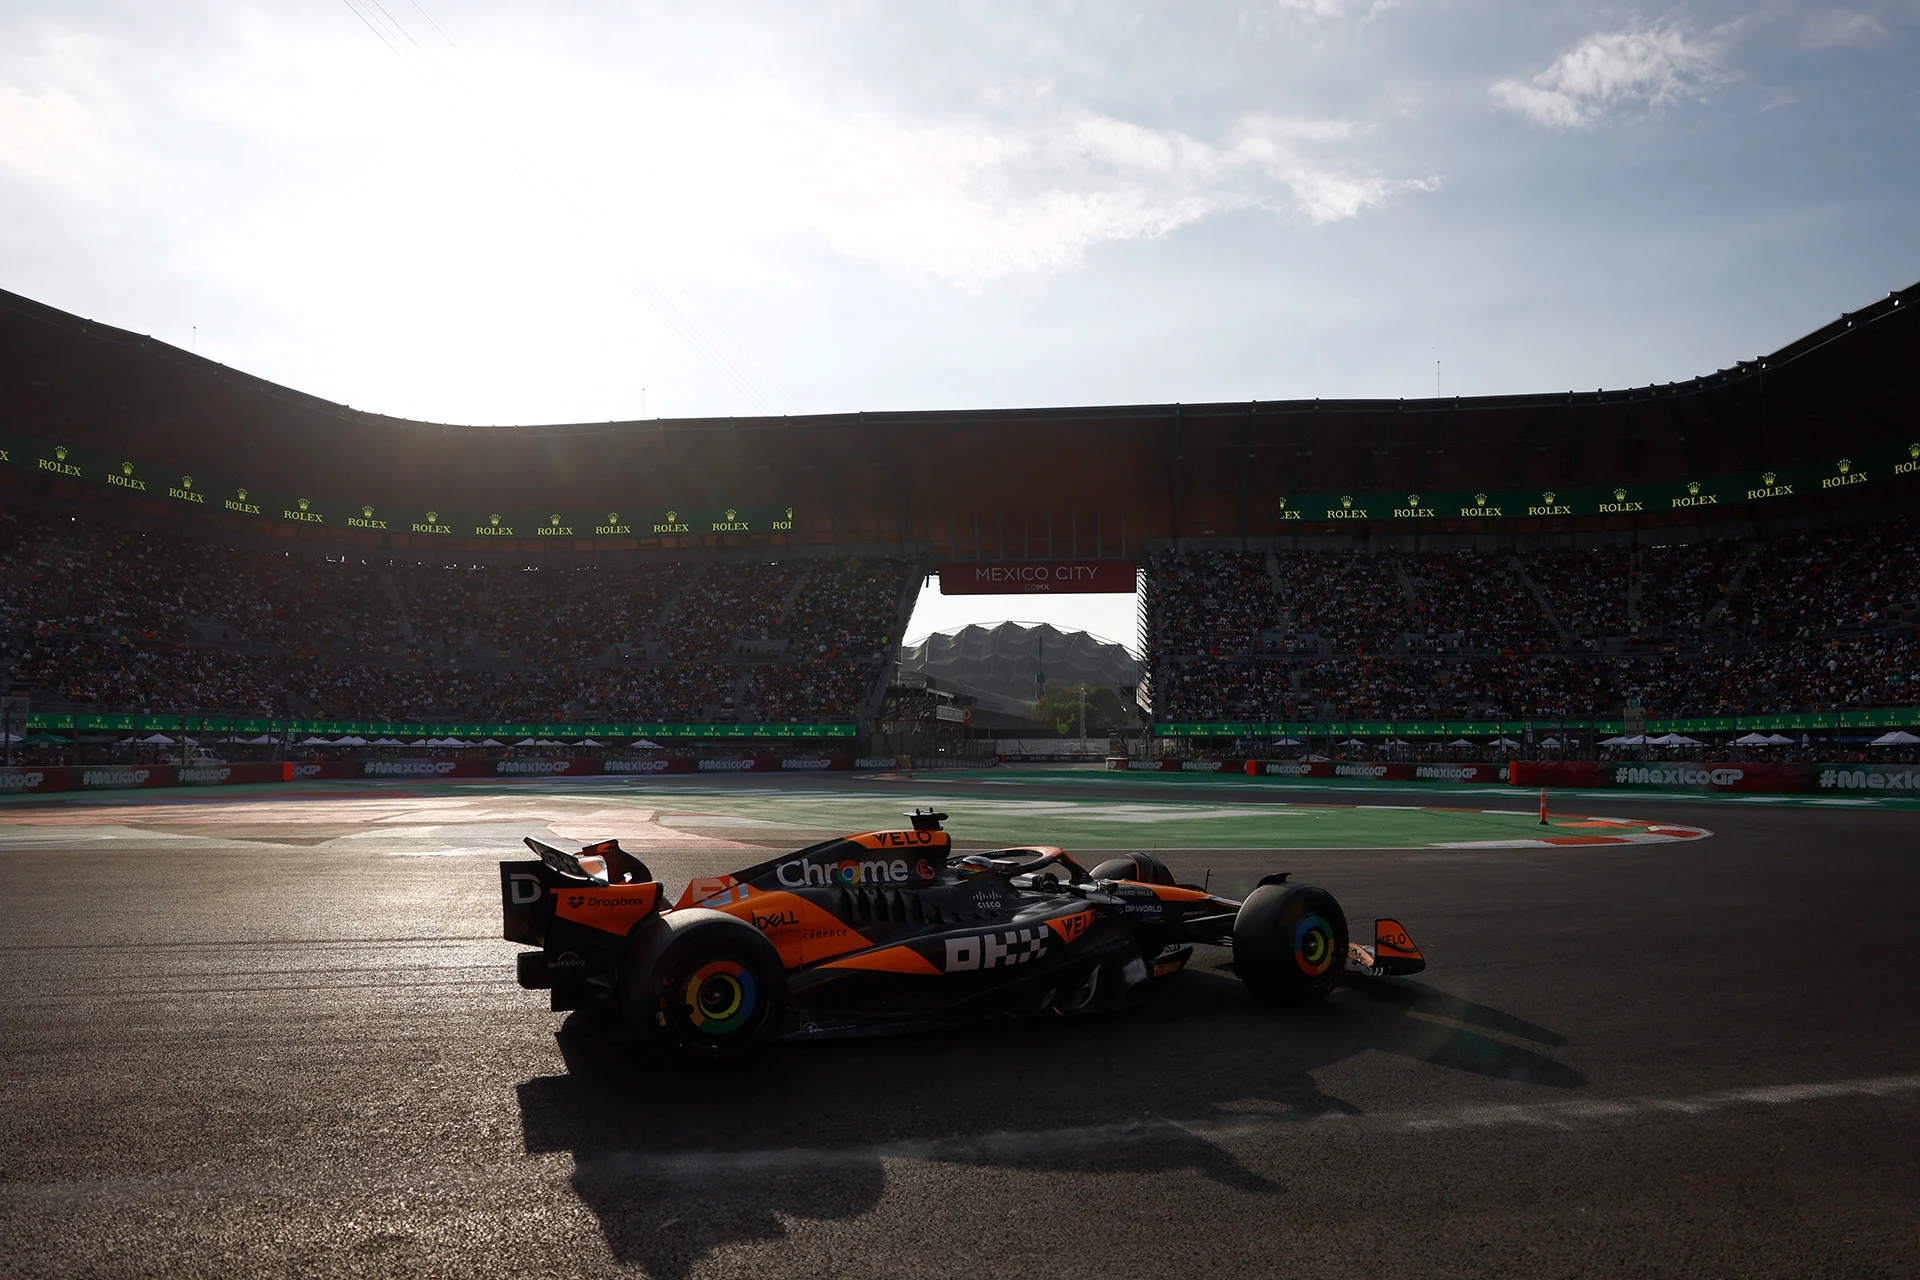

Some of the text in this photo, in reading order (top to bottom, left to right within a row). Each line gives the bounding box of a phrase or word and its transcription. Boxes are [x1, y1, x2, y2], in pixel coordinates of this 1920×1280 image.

[39, 458, 81, 477] ROLEX
[1895, 459, 1920, 475] ROL
[107, 474, 146, 491] ROLEX
[1823, 471, 1868, 489] ROLEX
[169, 487, 204, 503] ROLEX
[1748, 484, 1793, 500] ROLEX
[225, 500, 260, 515] ROLEX
[1599, 502, 1643, 513] ROLEX
[1672, 495, 1717, 509] ROLEX
[1327, 509, 1368, 519] ROLEX
[1394, 508, 1435, 517] ROLEX
[1461, 507, 1502, 517] ROLEX
[1529, 505, 1571, 516] ROLEX
[284, 511, 323, 523] ROLEX
[348, 517, 387, 529] ROLEX
[412, 523, 451, 534] ROLEX
[476, 527, 513, 536] ROLEX
[537, 527, 573, 536] ROLEX
[595, 525, 631, 535] ROLEX
[653, 524, 689, 533] ROLEX
[712, 522, 749, 531] ROLEX
[975, 566, 1099, 581] MEXICO CITY
[364, 761, 457, 775] #MexicoGP
[496, 761, 570, 773] #MexicoGP
[604, 760, 668, 771] #MexicoGP
[698, 759, 755, 770] #MexicoGP
[781, 758, 831, 769] #MexicoGP
[1265, 764, 1312, 774] #MexicoGP
[178, 768, 232, 782] #MexicoGP
[1335, 764, 1388, 777] #MexicoGP
[1416, 765, 1478, 779] #MexicoGP
[1615, 767, 1744, 786] #MexicoGP
[0, 772, 45, 788] icoGP
[83, 770, 150, 786] #MexicoGP
[1819, 769, 1920, 789] #Mexi
[874, 831, 932, 847] VELO
[776, 858, 909, 886] Chrome
[509, 873, 543, 905] D
[587, 896, 644, 908] Dropbox
[977, 901, 1001, 909] CISCO
[1124, 904, 1163, 913] DP WORLD
[758, 911, 799, 930] DELL
[803, 928, 848, 940] cadence
[547, 957, 586, 969] workday
